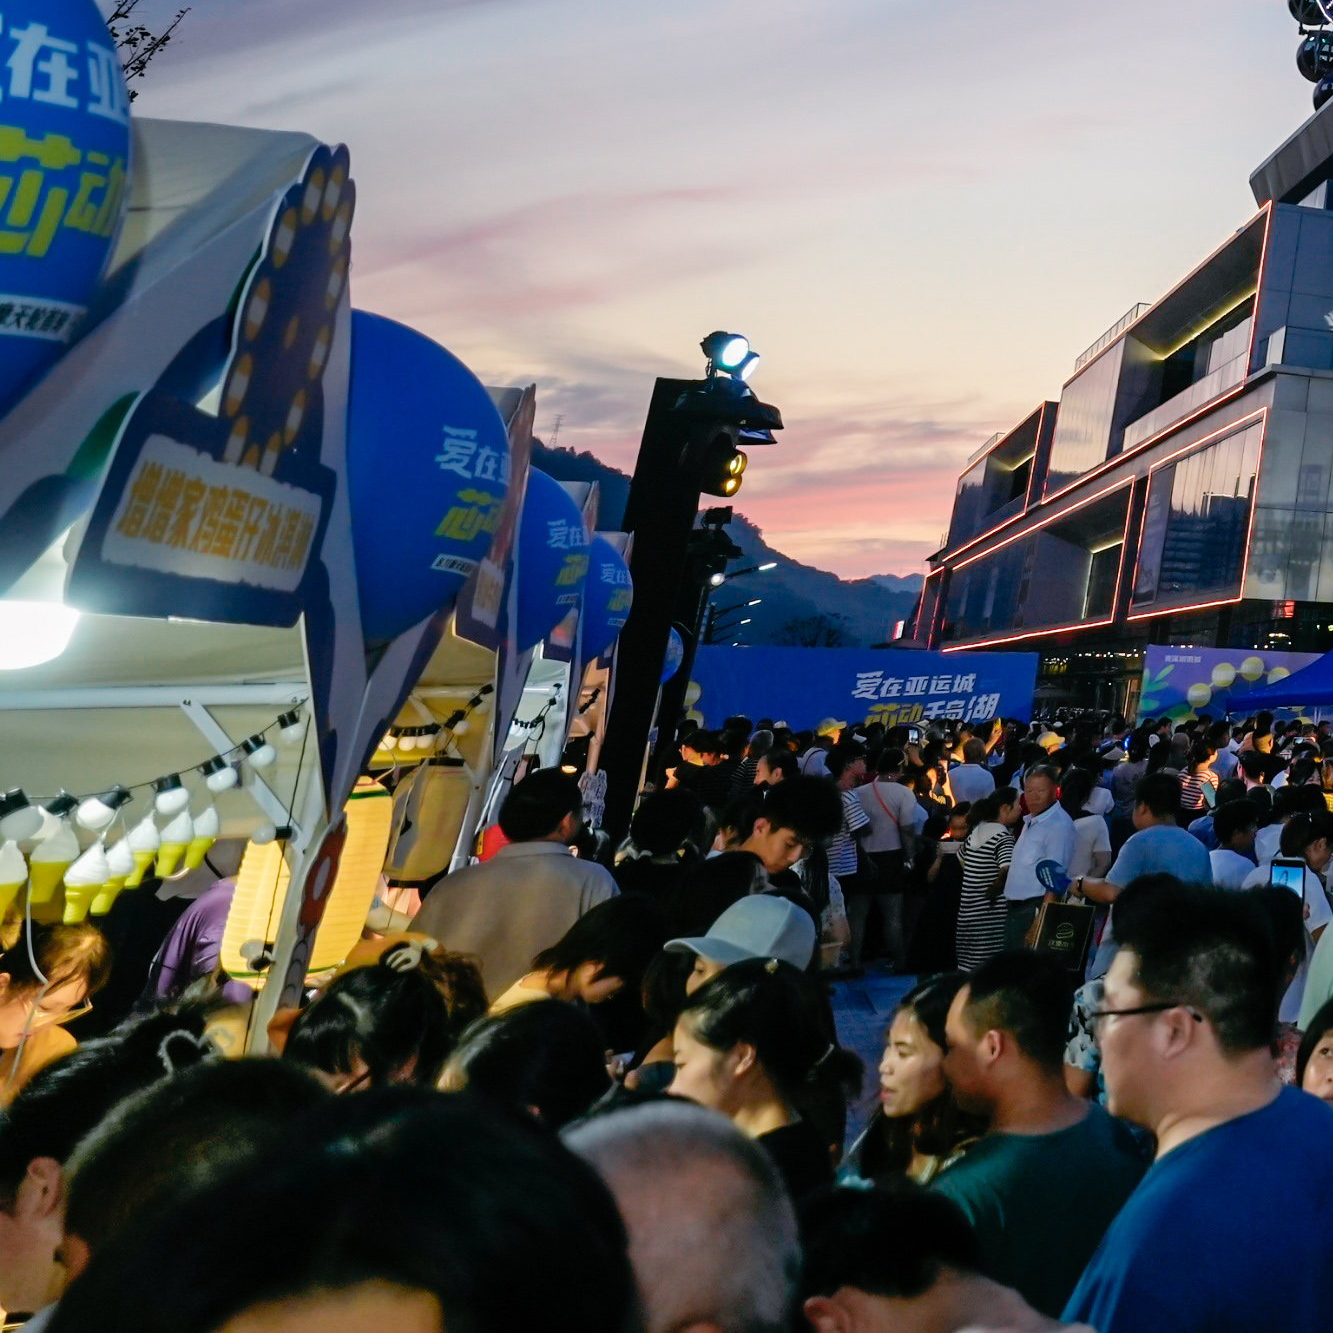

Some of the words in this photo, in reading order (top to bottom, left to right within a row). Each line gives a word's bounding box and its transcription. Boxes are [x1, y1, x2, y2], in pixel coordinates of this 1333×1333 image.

[851, 670, 976, 700] 爱在亚运城
